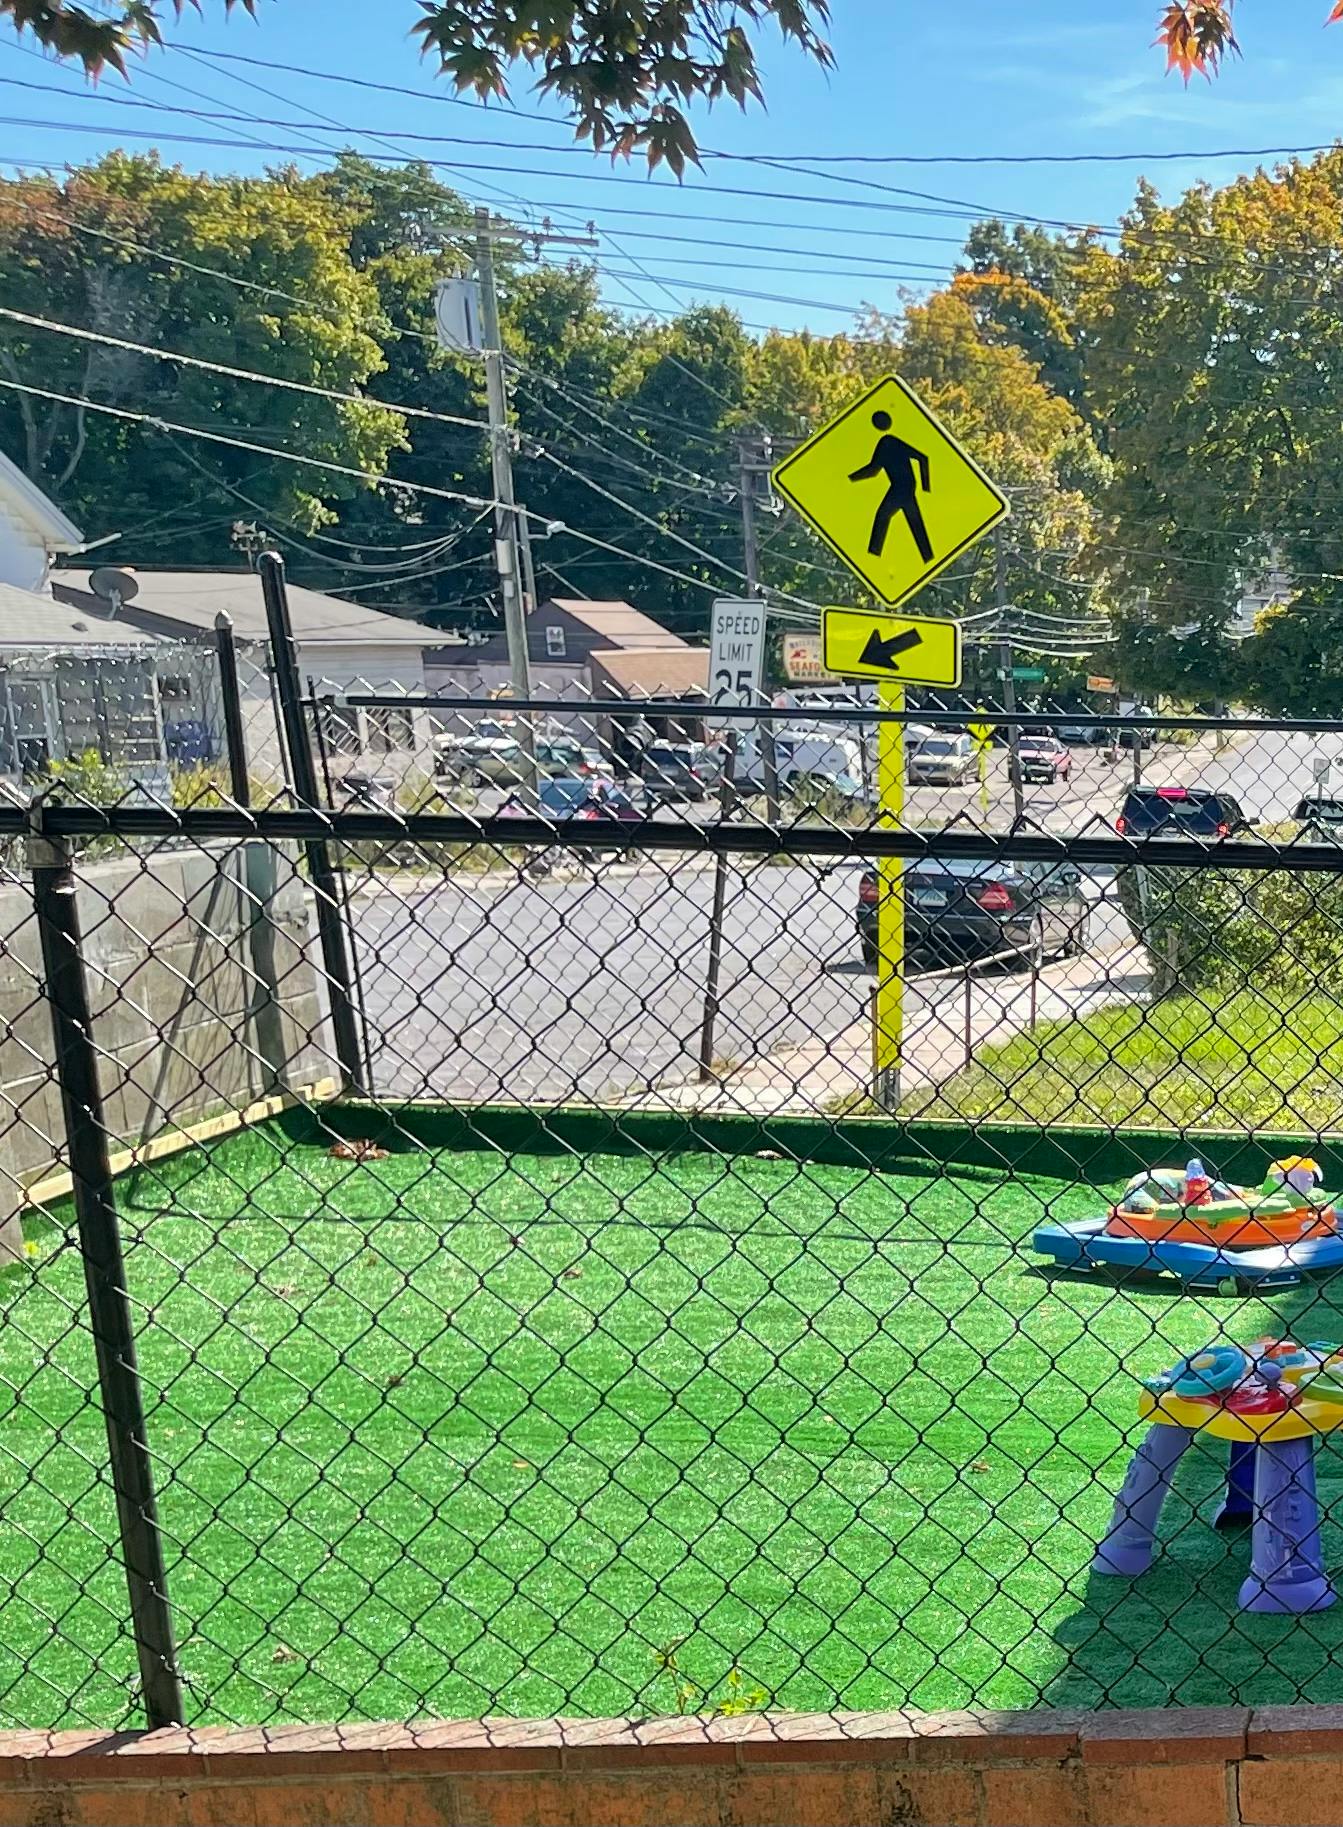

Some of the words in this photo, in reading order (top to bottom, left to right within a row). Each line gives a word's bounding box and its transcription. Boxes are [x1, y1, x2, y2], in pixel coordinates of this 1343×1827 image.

[716, 615, 760, 635] SPEED
[719, 643, 753, 662] LIMIT
[789, 661, 821, 672] SEAFO
[715, 669, 753, 706] 25
